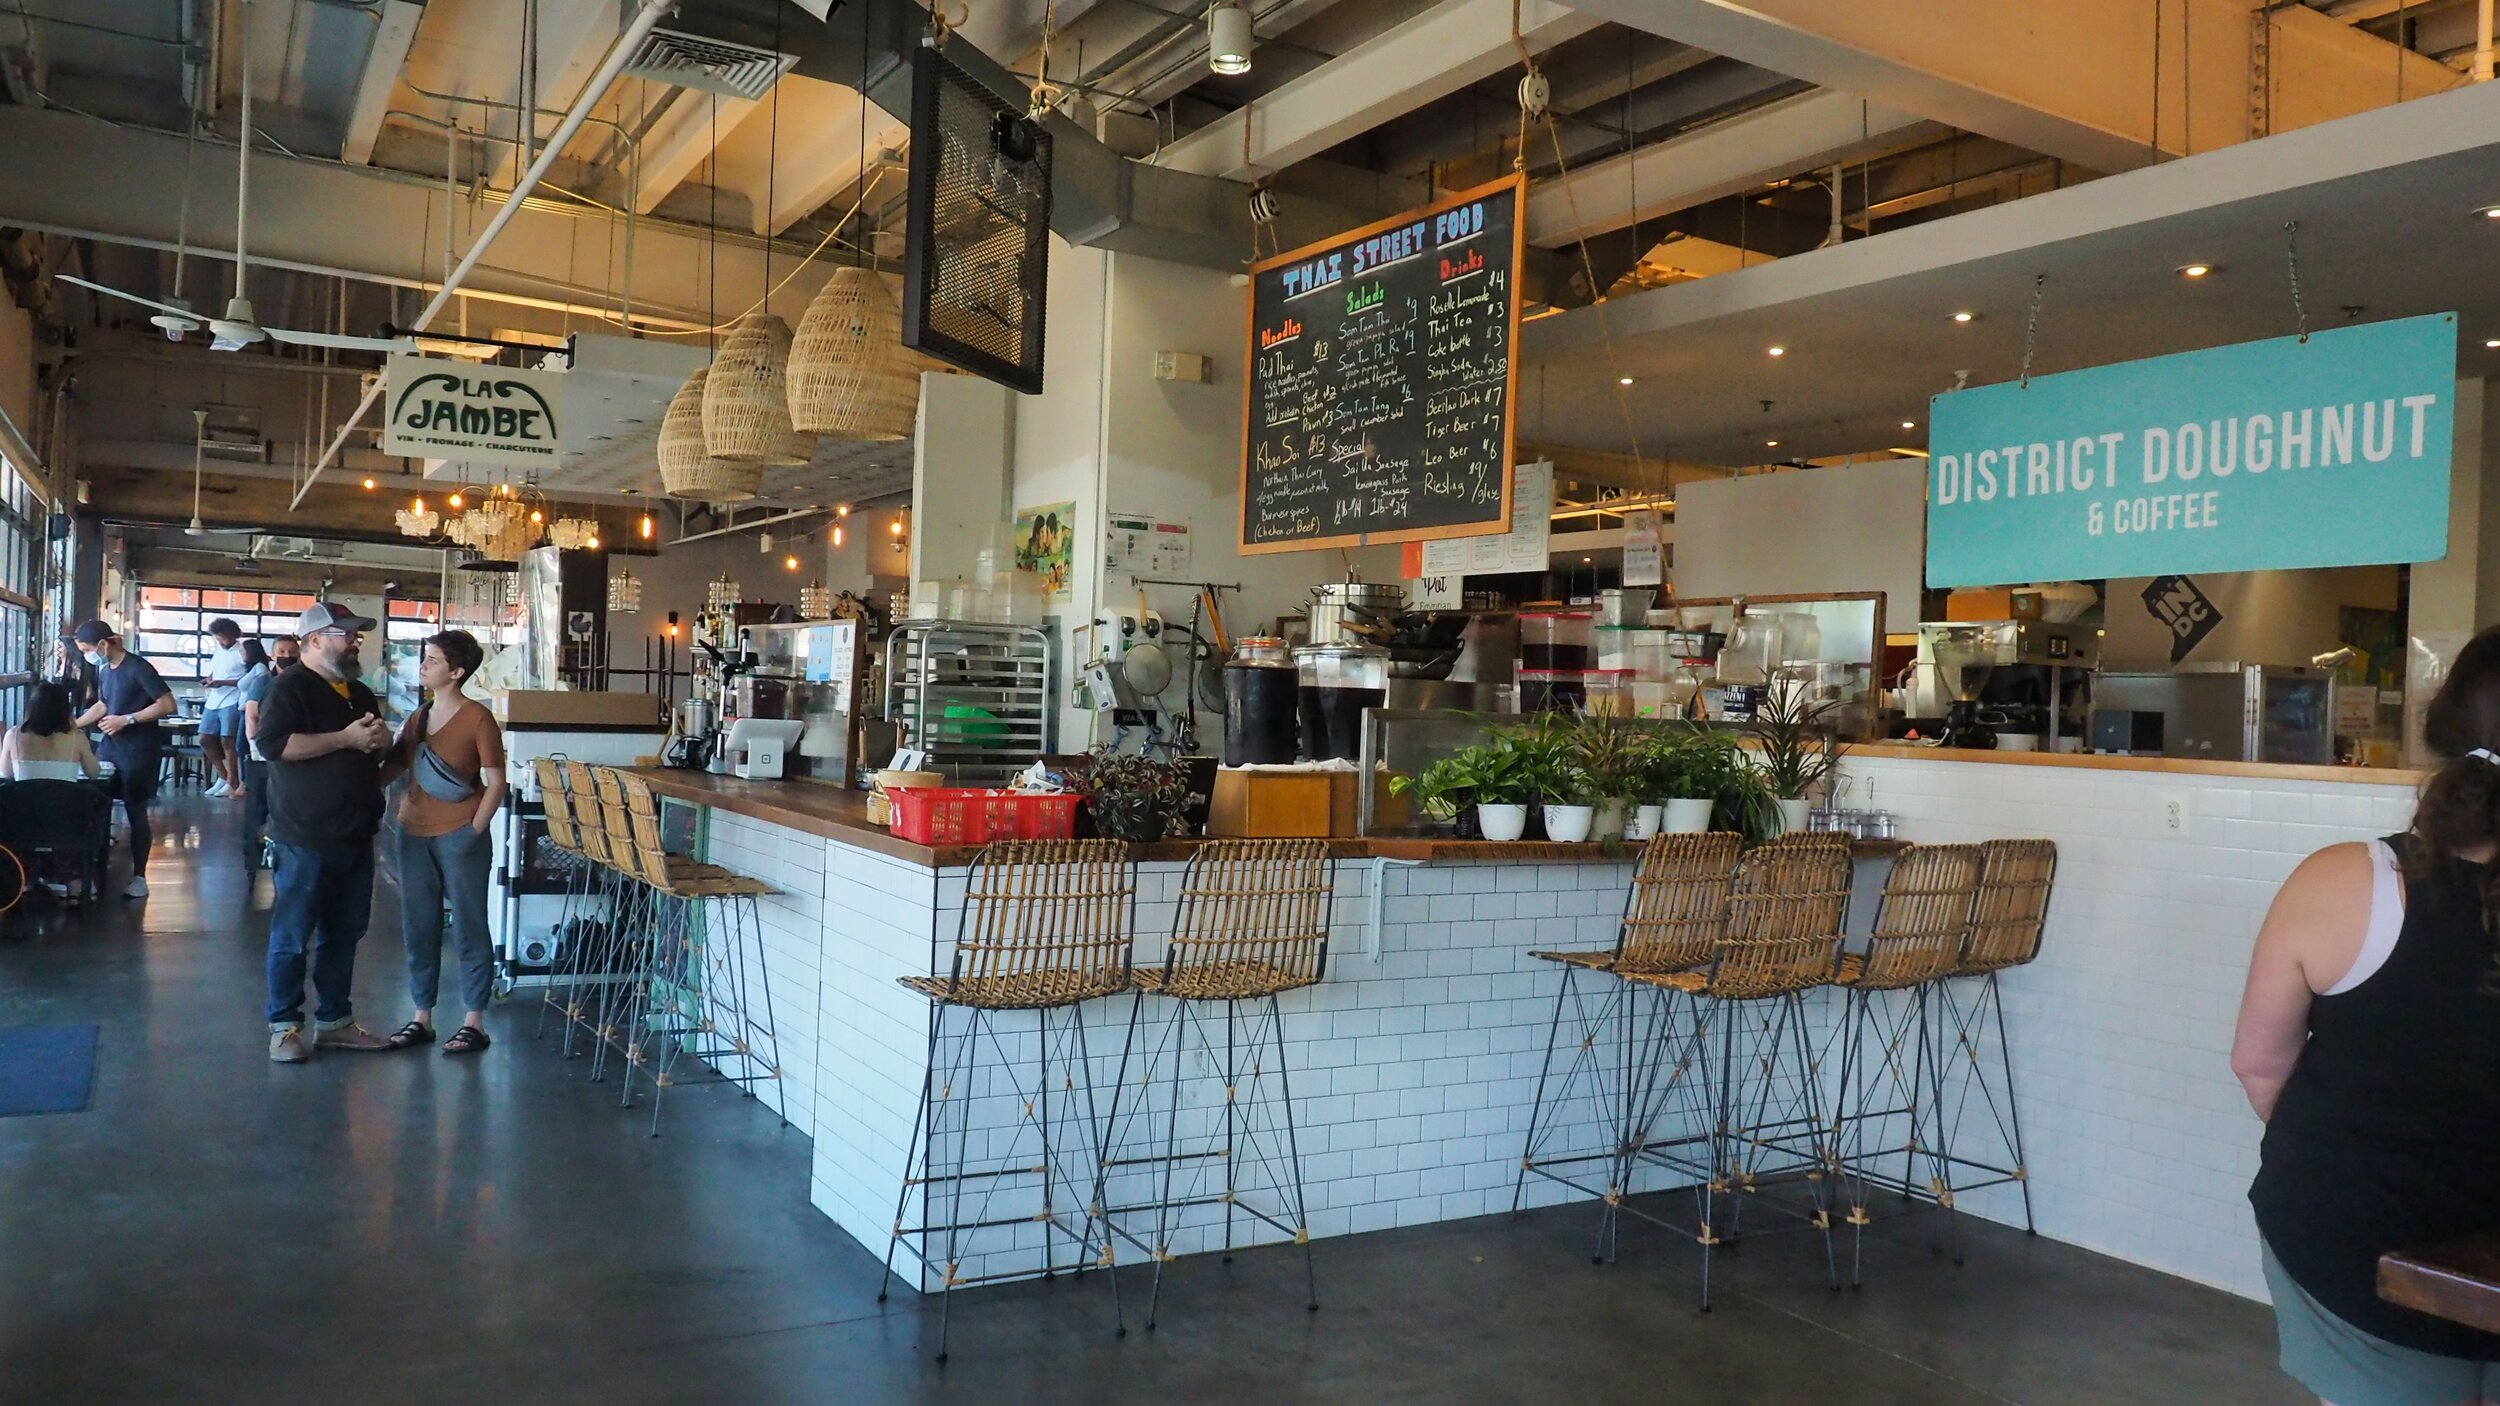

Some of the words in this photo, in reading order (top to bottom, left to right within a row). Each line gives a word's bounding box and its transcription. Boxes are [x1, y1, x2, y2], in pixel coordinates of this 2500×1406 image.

[1283, 253, 1342, 296] THAI
[1354, 222, 1425, 273] STREET
[1437, 203, 1483, 244] FOOD
[1440, 249, 1483, 280] Drinks
[1489, 269, 1504, 290] $4
[1347, 281, 1384, 313] Salads
[1262, 319, 1301, 347] Noodles
[1428, 319, 1449, 338] Thai
[1453, 312, 1472, 327] Tea
[1487, 302, 1504, 318] $3
[1486, 326, 1502, 347] $3
[1259, 358, 1273, 379] Pad
[1275, 351, 1294, 375] Thai
[1313, 341, 1328, 358] $13
[1451, 358, 1472, 372] Soda
[463, 379, 492, 399] LA
[1460, 391, 1480, 408] Dark
[1485, 386, 1502, 406] $7
[407, 399, 541, 440] JAMBE
[1426, 421, 1449, 438] Tiger
[1454, 417, 1476, 432] Beer
[1483, 413, 1499, 431] $7
[426, 438, 474, 447] FROMAGE
[486, 443, 553, 455] CHARCUTERIE
[1257, 441, 1281, 472] Khao
[1282, 435, 1299, 464] Soi
[1329, 431, 1365, 463] Special
[1426, 448, 1442, 465] Leo
[1449, 446, 1468, 459] Beer
[1483, 438, 1497, 459] $6
[1937, 432, 2124, 506] DISTRICT
[2143, 394, 2436, 484] DOUGHNUT
[1342, 459, 1358, 477] Sai
[1424, 472, 1465, 498] Riesling
[1286, 526, 1294, 535] or
[1296, 516, 1320, 535] Beef)
[2088, 501, 2103, 536] &
[2114, 491, 2219, 534] COFFEE
[2156, 579, 2197, 623] IN
[2174, 601, 2208, 638] DC
